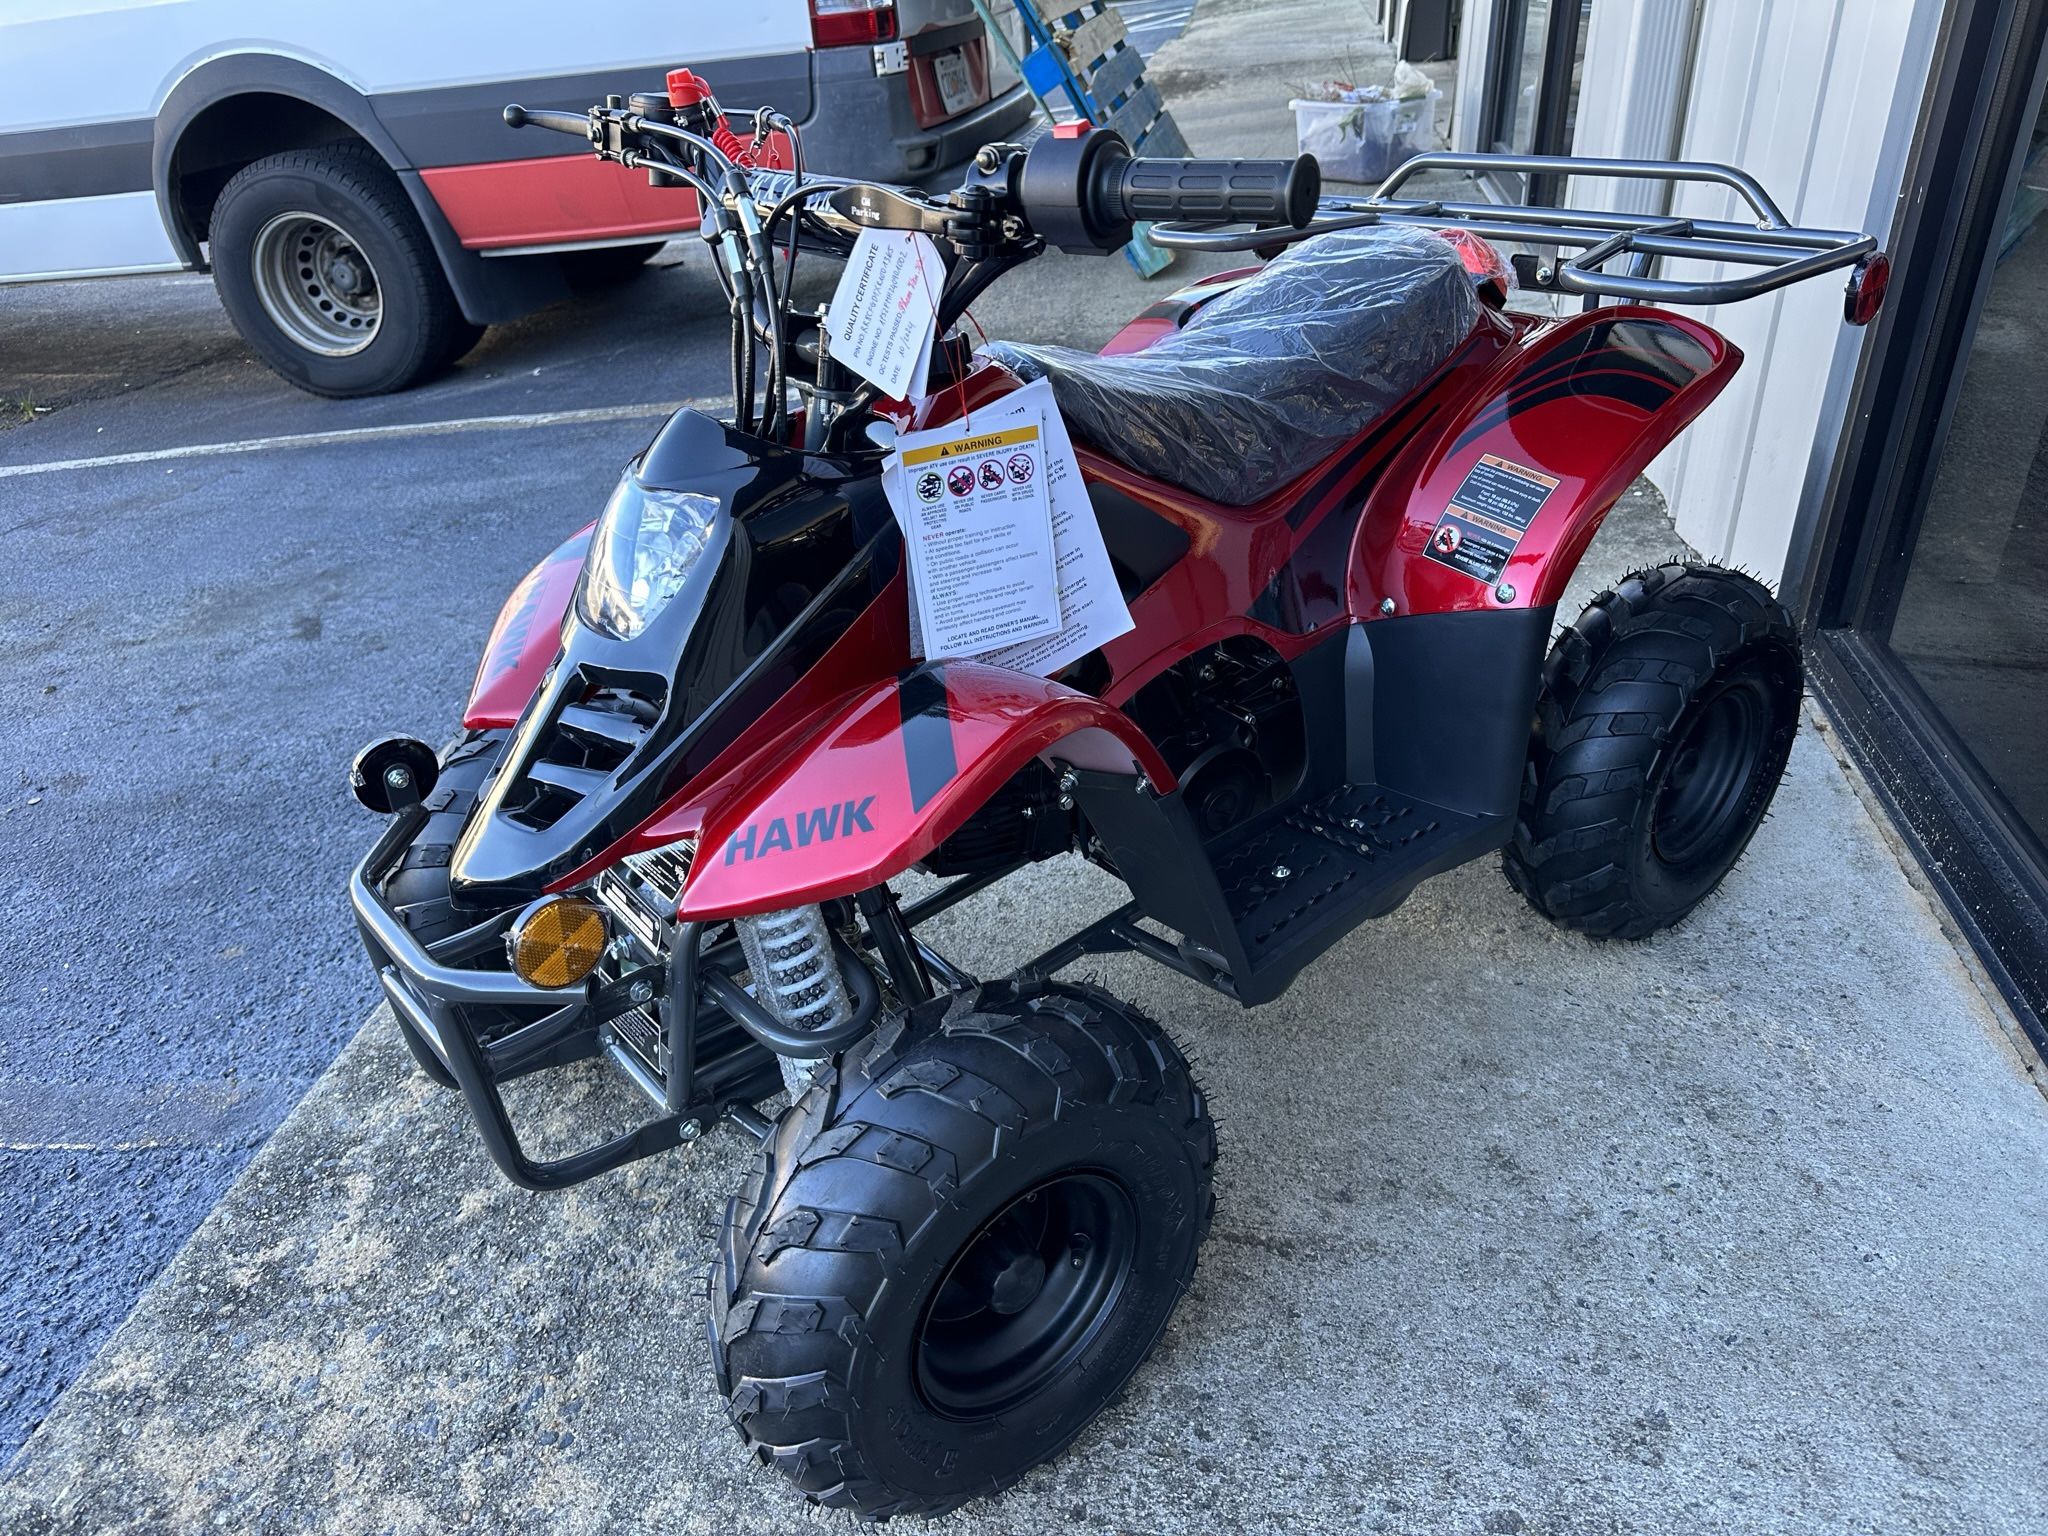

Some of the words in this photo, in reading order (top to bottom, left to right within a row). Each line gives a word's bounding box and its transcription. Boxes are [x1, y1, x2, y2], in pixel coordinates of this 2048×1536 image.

[852, 206, 880, 220] Parking
[844, 302, 860, 341] QUALITY
[856, 243, 879, 301] CERTIFICATE
[866, 340, 878, 367] ENGINE
[882, 341, 894, 362] TESTS
[879, 364, 886, 375] QC
[954, 436, 1001, 452] WARNING
[908, 465, 928, 474] Improper
[976, 450, 994, 459] SEVERE
[996, 447, 1012, 455] INJURY
[1053, 458, 1063, 466] the
[1506, 464, 1543, 481] WARNING
[1471, 515, 1507, 533] WARNING
[922, 532, 943, 541] NEVER
[944, 527, 966, 536] operate:
[927, 539, 946, 547] Without
[947, 535, 964, 543] proper
[965, 530, 983, 539] training
[935, 544, 953, 553] speeds
[993, 531, 1005, 539] skills
[939, 557, 953, 565] public
[955, 553, 968, 561] roads
[974, 547, 994, 556] collision
[1005, 554, 1018, 562] affect
[1019, 550, 1037, 558] balance
[1059, 551, 1074, 561] screw
[1065, 553, 1083, 566] locking
[938, 562, 957, 571] another
[940, 576, 960, 585] steering
[971, 567, 992, 577] increase
[936, 584, 951, 592] losing
[947, 595, 963, 604] proper
[964, 591, 978, 600] riding
[979, 585, 1005, 596] techniques
[1070, 583, 1087, 595] unlock
[933, 605, 950, 613] vehicle
[951, 599, 974, 609] overturns
[1004, 588, 1018, 596] rough
[1082, 600, 1093, 609] start
[936, 622, 957, 632] seriously
[973, 613, 994, 623] handling
[953, 613, 969, 622] paved
[940, 640, 962, 651] FOLLOW
[973, 627, 1013, 642] INSTRUCTIONS
[1023, 618, 1048, 629] WARNINGS
[947, 632, 967, 642] LOCATE
[995, 619, 1018, 629] OWNER'S
[1015, 660, 1026, 668] will
[1026, 655, 1036, 663] not
[1036, 648, 1048, 658] start
[1056, 638, 1066, 648] stay
[1016, 650, 1030, 660] lever
[1031, 643, 1046, 652] down
[1047, 634, 1059, 645] once
[1036, 654, 1051, 664] screw
[1052, 642, 1070, 654] inward
[1078, 632, 1086, 640] the
[988, 653, 997, 661] the
[724, 795, 876, 866] HAWK
